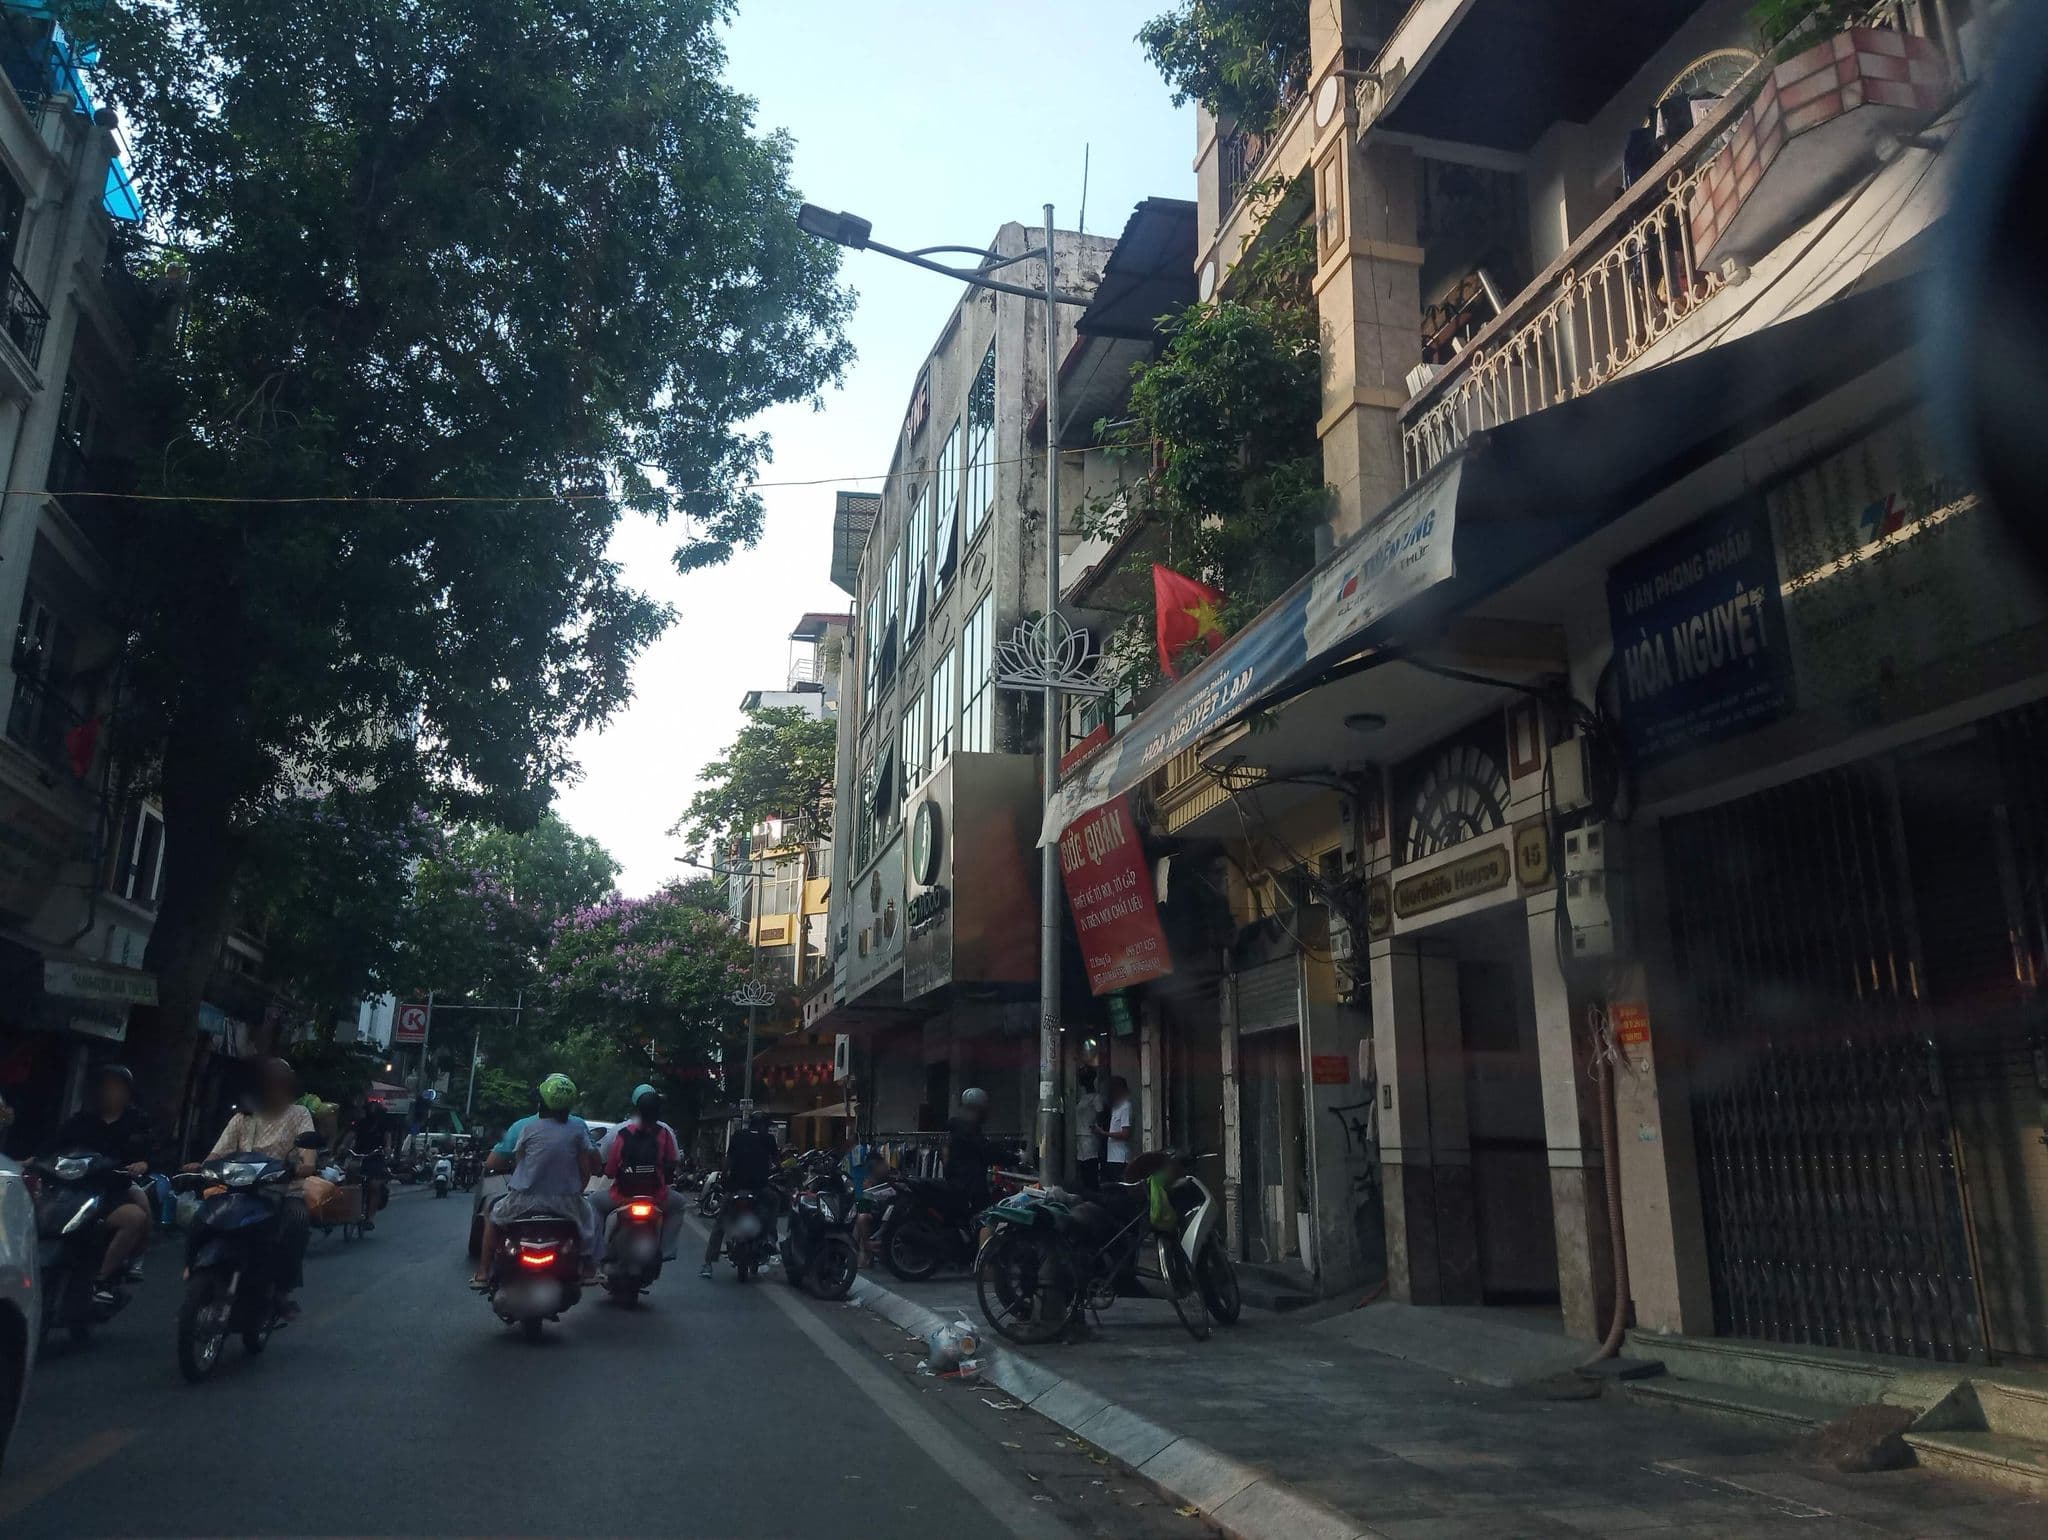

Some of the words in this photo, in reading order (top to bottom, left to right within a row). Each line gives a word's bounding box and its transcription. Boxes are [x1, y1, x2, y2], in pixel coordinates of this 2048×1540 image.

[1625, 626, 1674, 703] HÒA
[1672, 579, 1769, 682] NGUYỆT
[1219, 666, 1254, 708] LAN
[1522, 843, 1541, 868] 15
